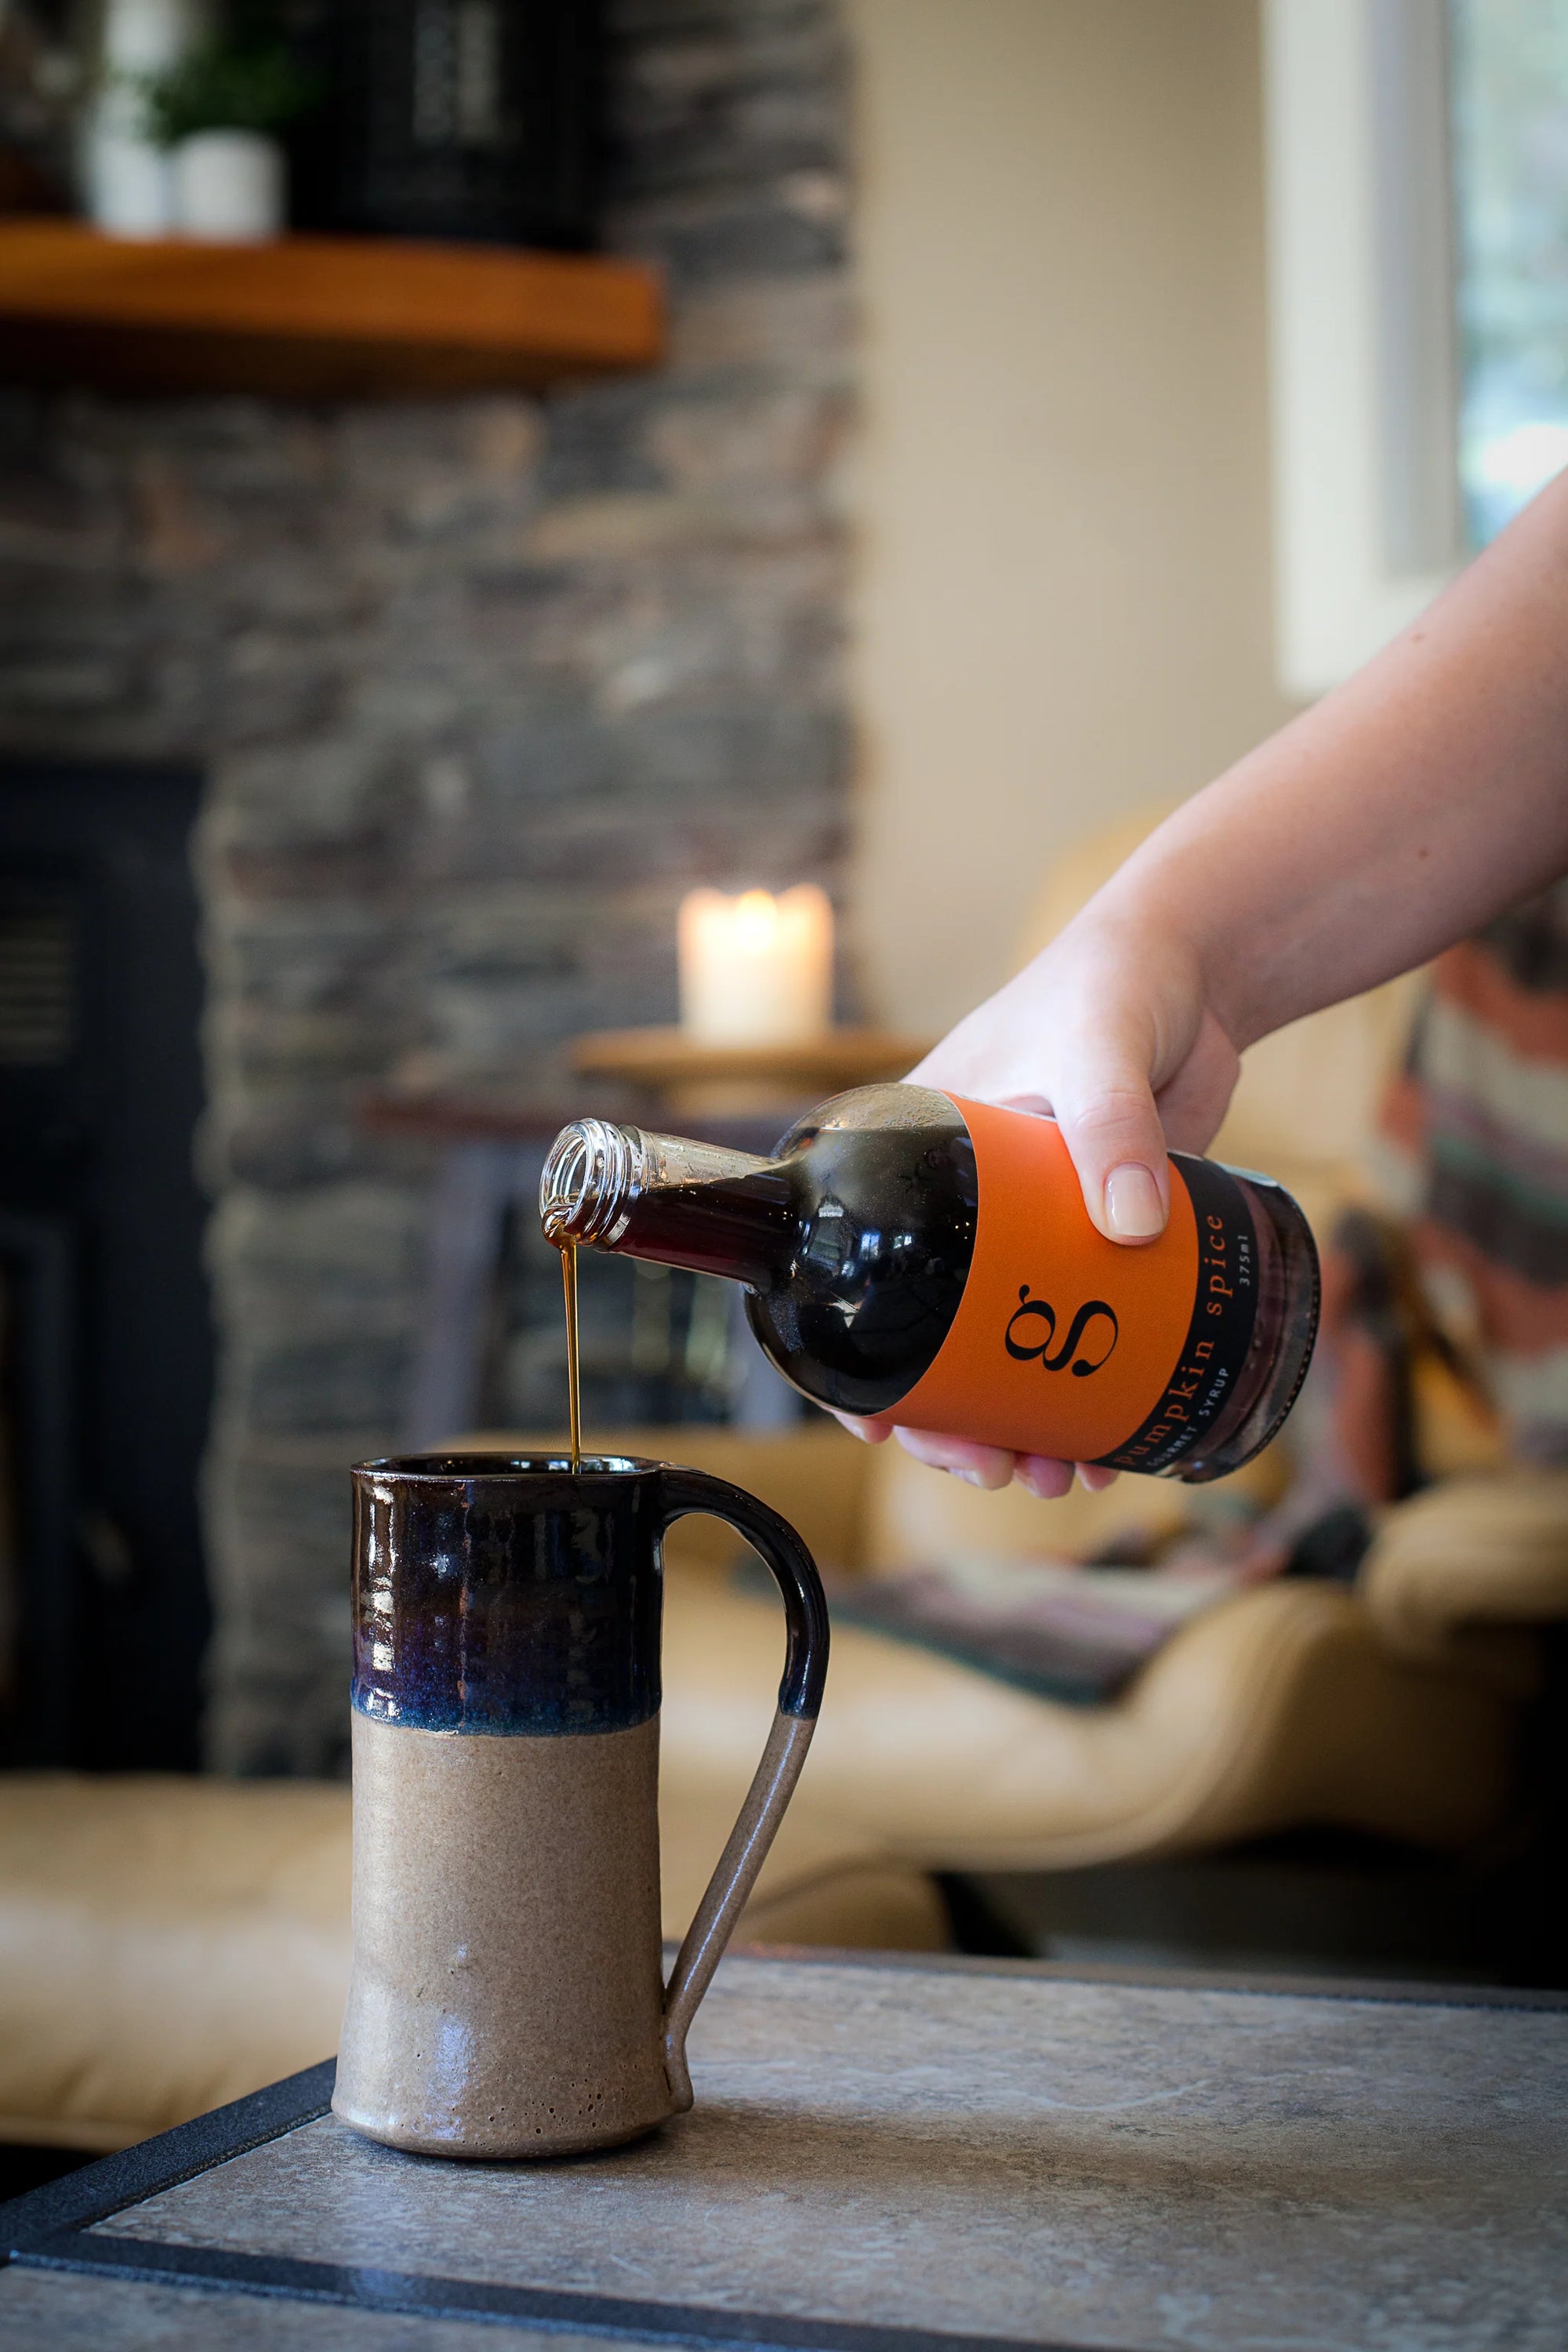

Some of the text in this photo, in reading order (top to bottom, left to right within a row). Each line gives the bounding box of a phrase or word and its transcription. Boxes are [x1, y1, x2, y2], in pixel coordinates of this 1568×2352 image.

[1237, 1234, 1251, 1286] 375ml
[1004, 1284, 1119, 1377] g
[1113, 1215, 1233, 1466] pumpkin spice
[1198, 1367, 1229, 1417] SYRUP
